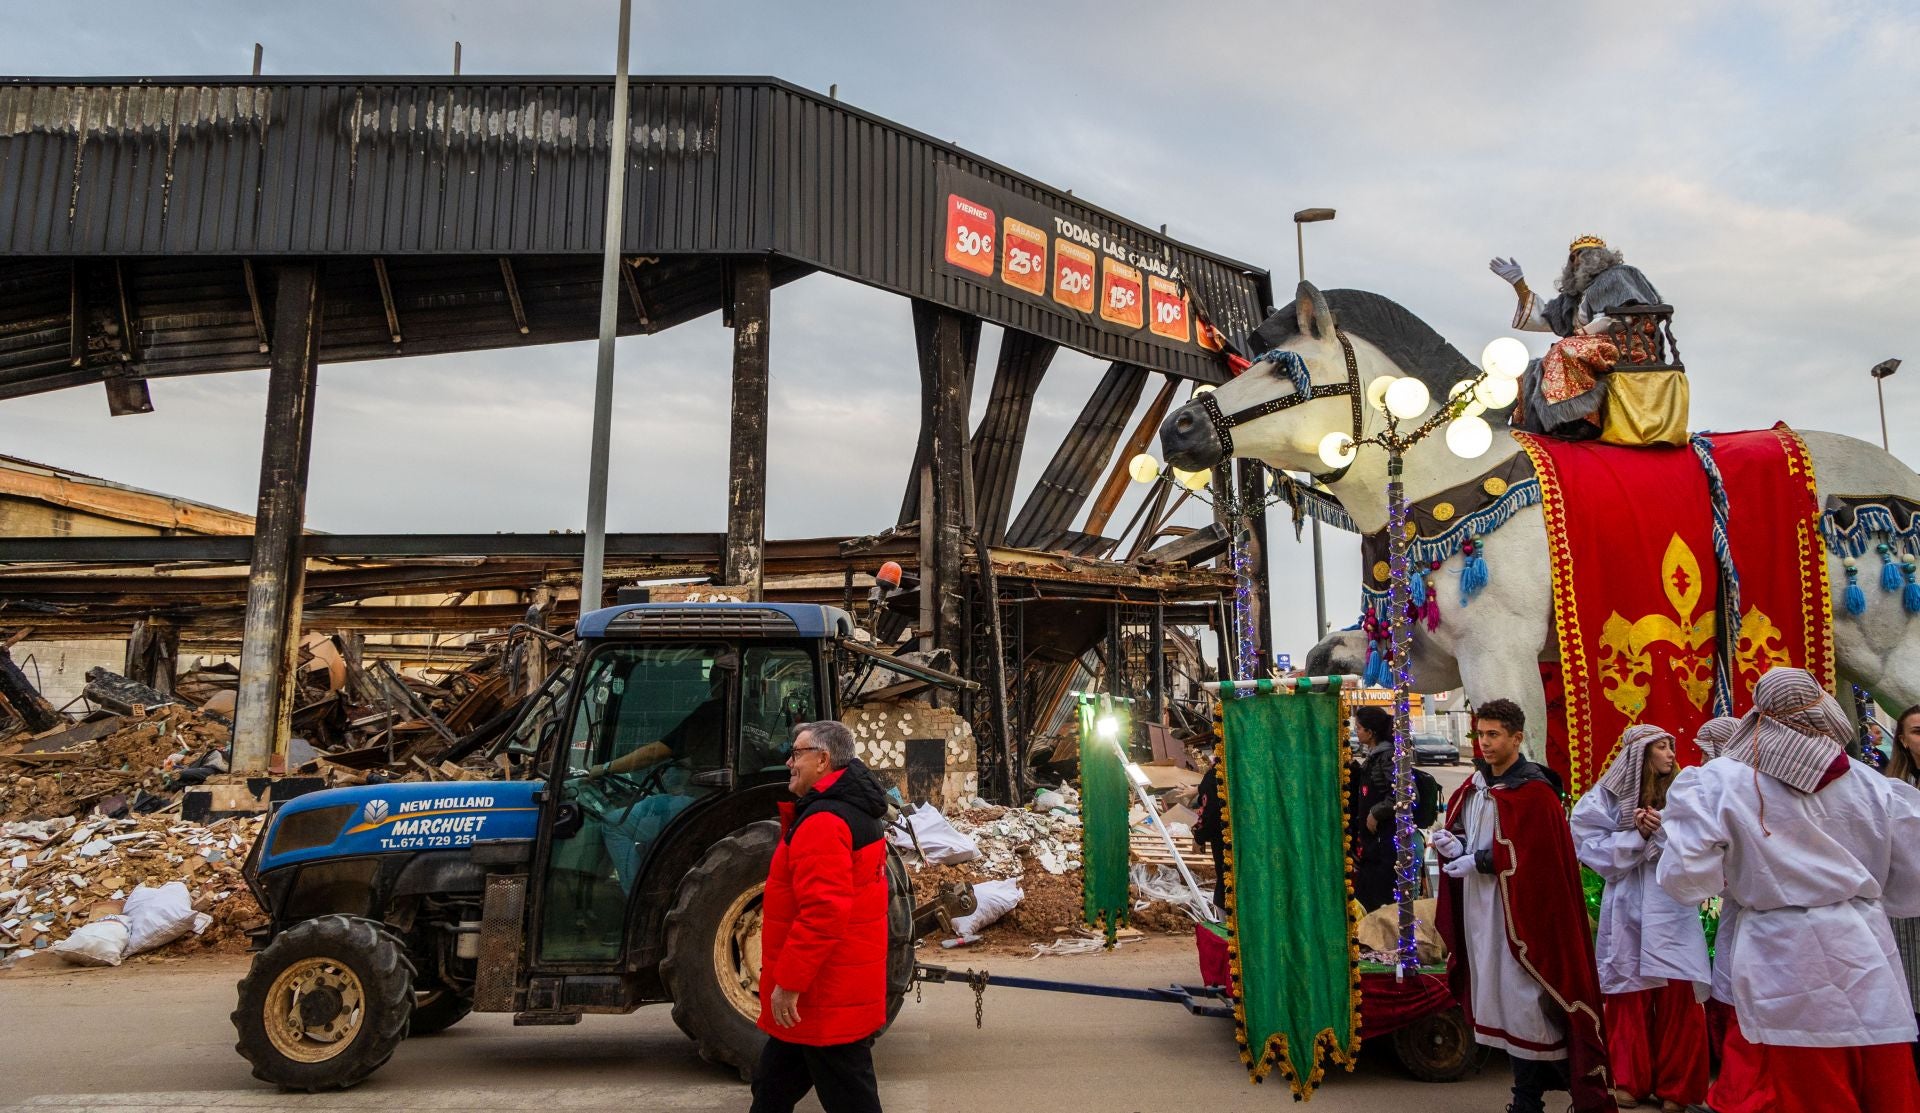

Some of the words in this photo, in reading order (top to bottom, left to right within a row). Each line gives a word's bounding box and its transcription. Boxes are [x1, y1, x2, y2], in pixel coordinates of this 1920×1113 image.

[956, 201, 988, 220] VIERNES
[955, 225, 992, 256] 30€
[1054, 216, 1100, 249] TODAS
[1103, 237, 1126, 260] LAS
[1128, 252, 1168, 277] CAJAS
[1008, 247, 1042, 275] 25€
[1060, 267, 1091, 294] 20€
[1110, 286, 1135, 309] 15€
[1156, 301, 1182, 324] 10€
[399, 800, 432, 813] NEW
[433, 796, 495, 810] HOLLAND
[391, 815, 487, 836] MARCHUET
[380, 836, 424, 849] TL.674
[428, 835, 451, 847] 729
[454, 833, 477, 846] 251
